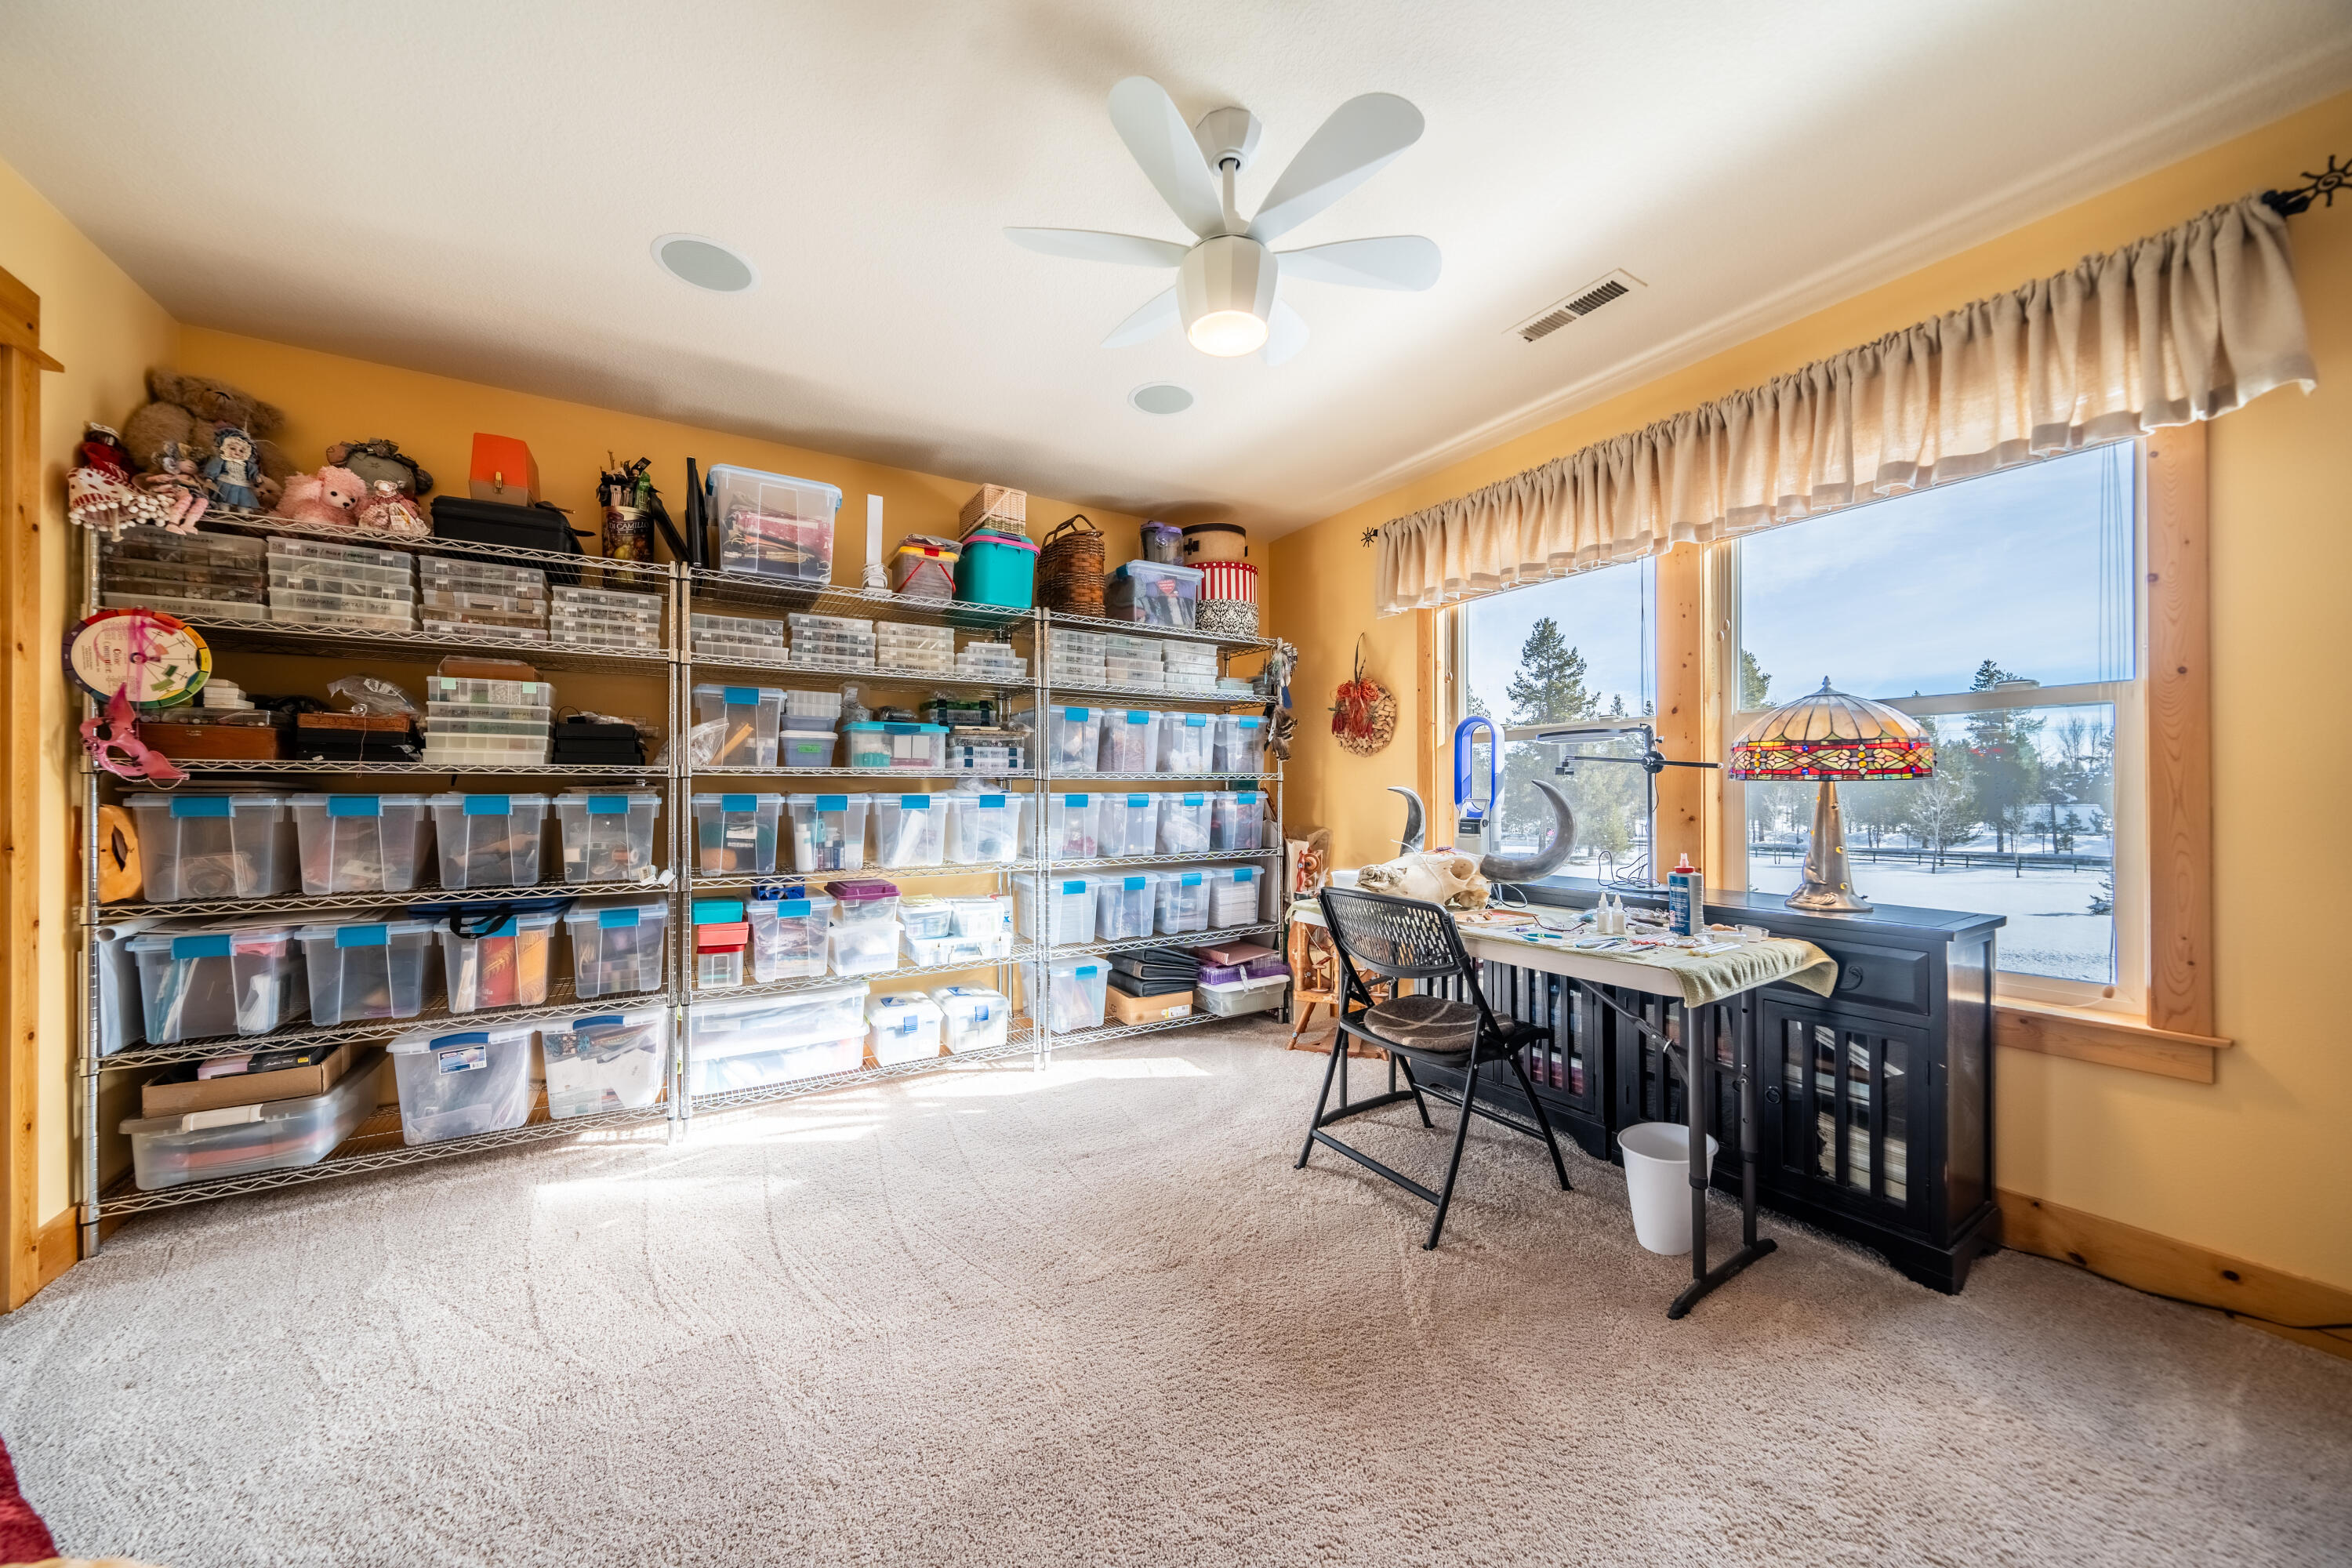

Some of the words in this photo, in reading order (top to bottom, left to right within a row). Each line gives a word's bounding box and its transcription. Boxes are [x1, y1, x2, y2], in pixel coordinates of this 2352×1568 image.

[296, 597, 334, 606] HANDMADE
[190, 605, 216, 614] BEADS
[1109, 1002, 1117, 1013] UGG
